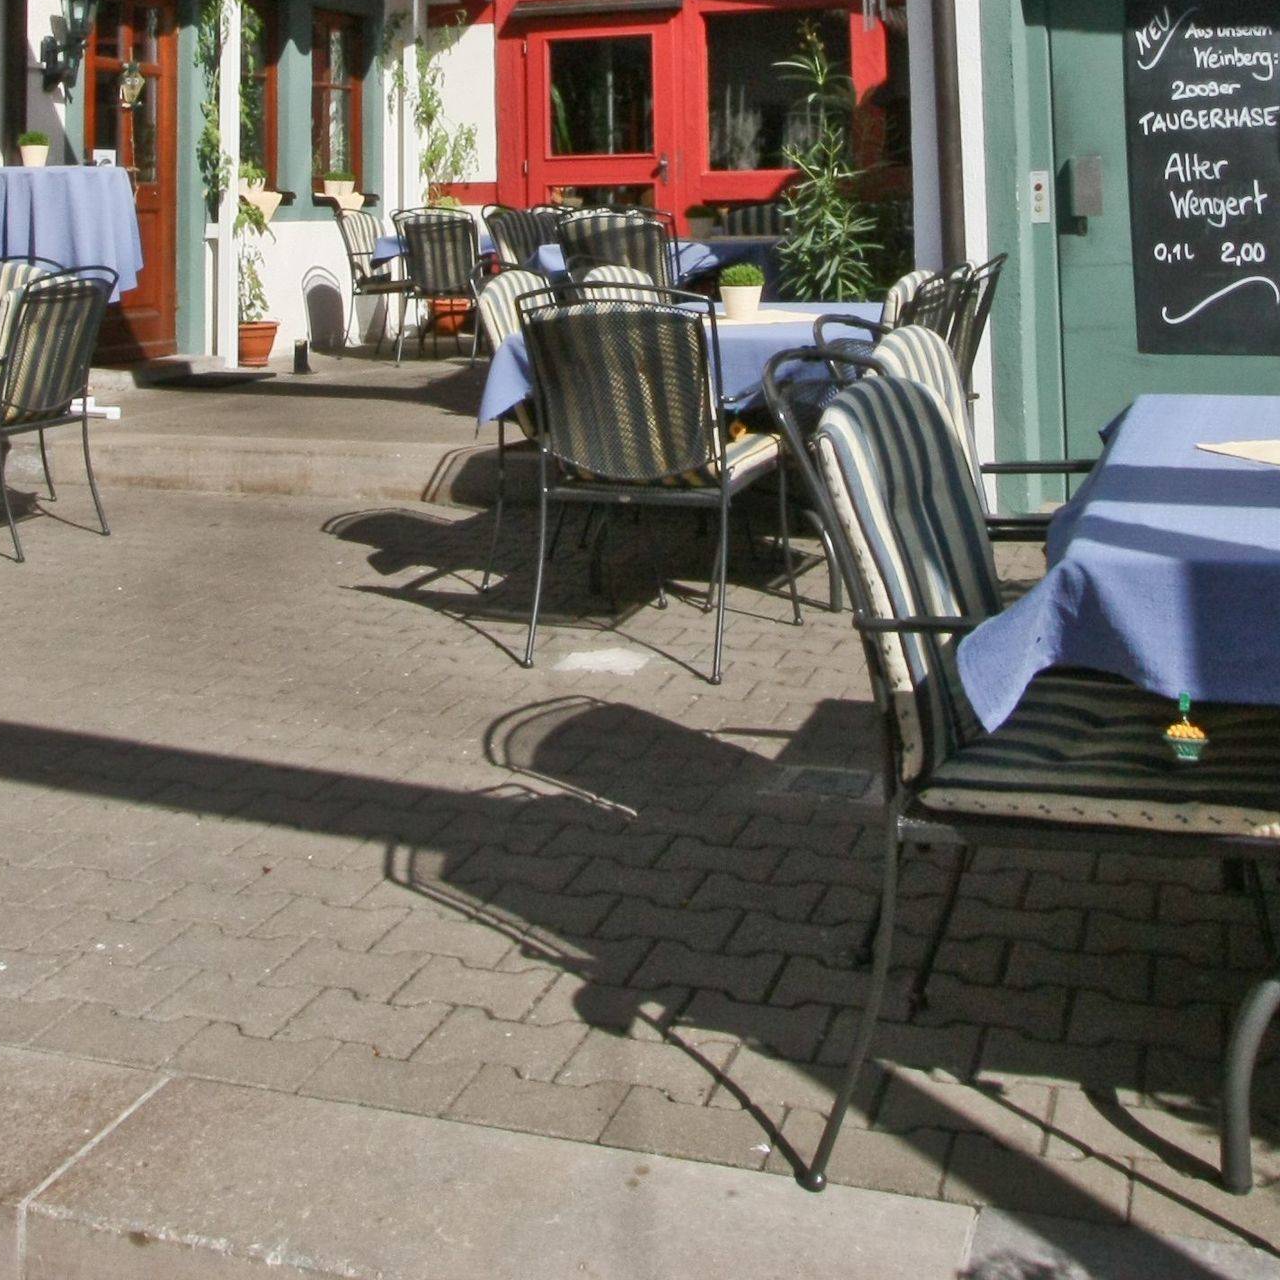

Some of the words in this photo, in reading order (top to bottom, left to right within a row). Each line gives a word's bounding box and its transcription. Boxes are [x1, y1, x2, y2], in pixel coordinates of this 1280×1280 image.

[1134, 5, 1169, 56] NEU
[1184, 22, 1214, 39] Aus
[1194, 46, 1280, 81] Weinberg:
[1138, 106, 1280, 135] TAUBERHASE
[1164, 153, 1229, 182] Alter
[1170, 180, 1268, 227] Wengert
[1220, 241, 1266, 266] 2,00
